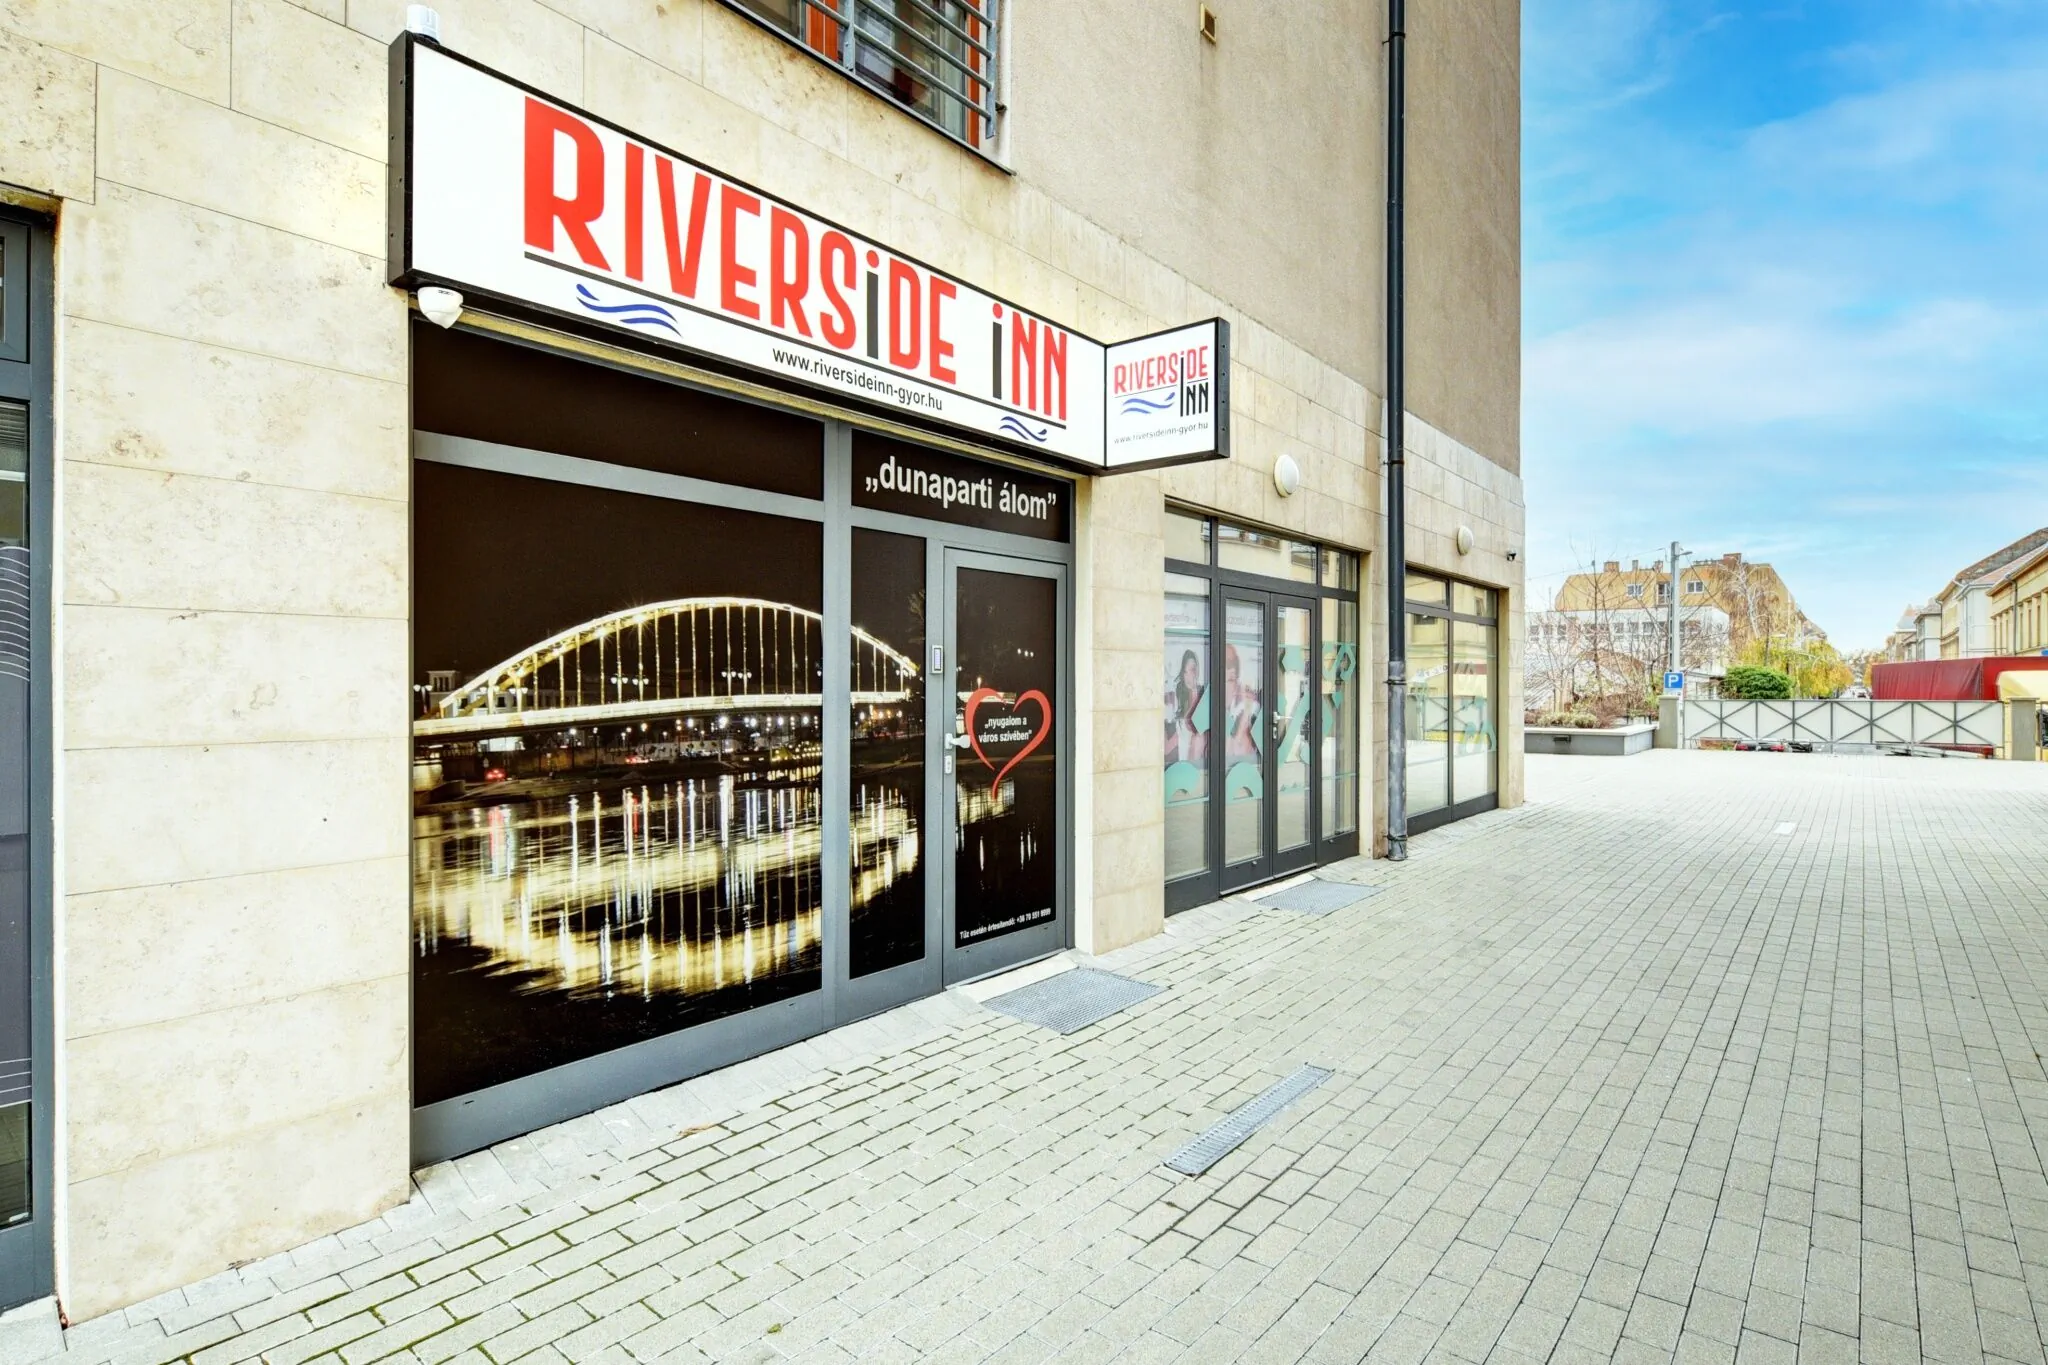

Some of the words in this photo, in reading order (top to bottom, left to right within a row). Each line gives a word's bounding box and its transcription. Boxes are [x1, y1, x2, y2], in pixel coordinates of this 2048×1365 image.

[772, 348, 943, 411] www.riversideinn-gyor.hu
[1114, 421, 1208, 444] www.riversideinn-gyor.hu
[1668, 674, 1679, 688] P
[1022, 717, 1027, 725] a
[978, 732, 999, 743] város
